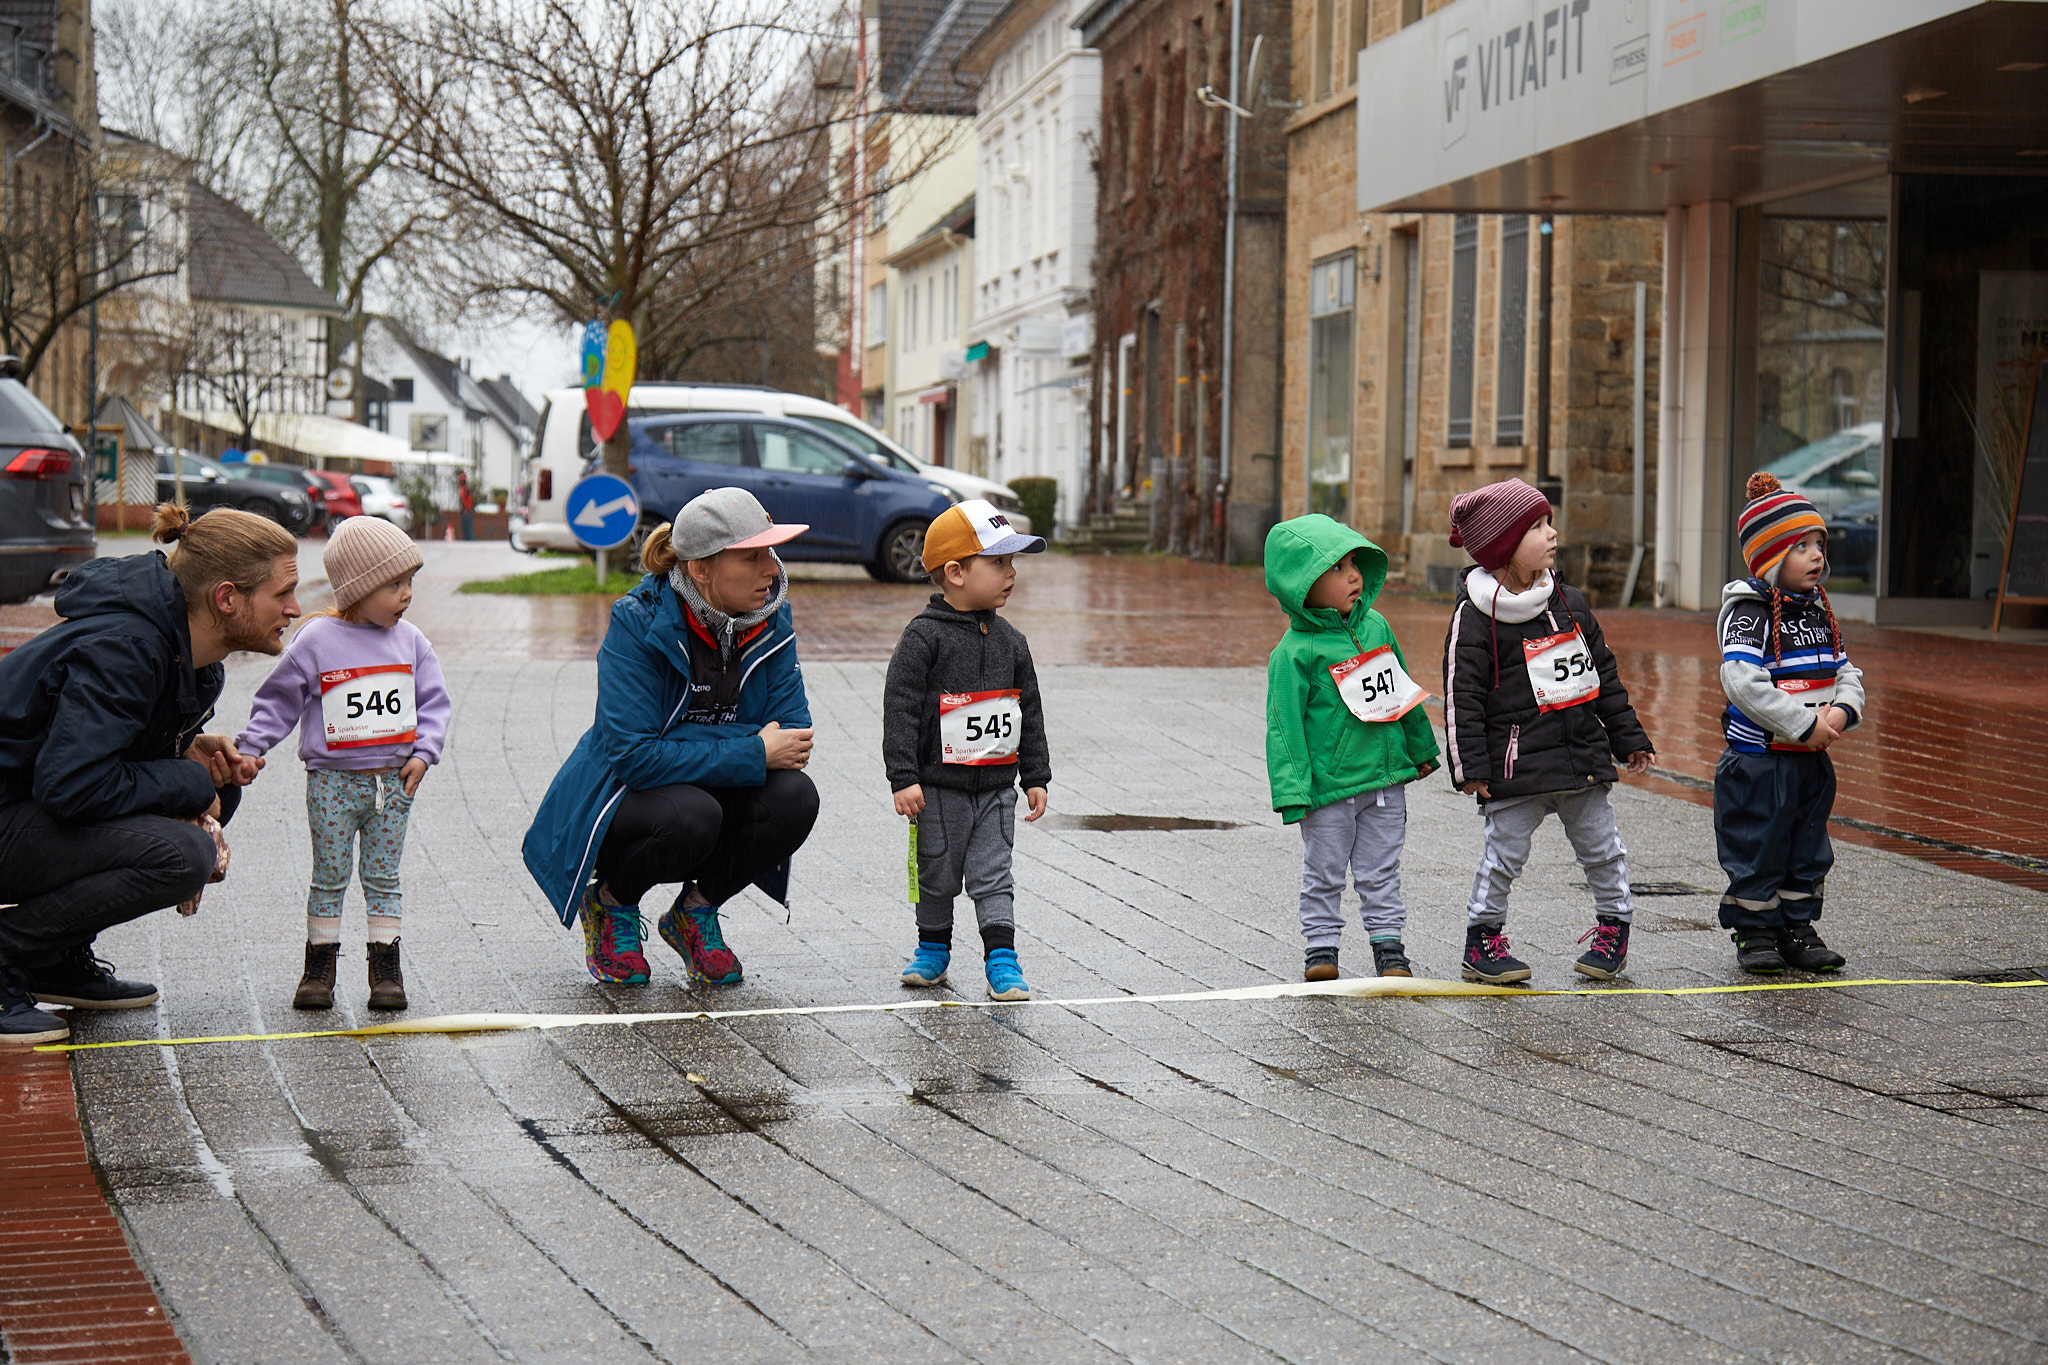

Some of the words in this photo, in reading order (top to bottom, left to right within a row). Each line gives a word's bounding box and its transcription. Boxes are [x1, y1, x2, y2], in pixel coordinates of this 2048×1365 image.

[1478, 0, 1590, 111] VITAFIT
[1613, 47, 1647, 73] FITNESS
[1780, 619, 1811, 634] asc
[1793, 631, 1828, 646] ahlen
[1361, 667, 1395, 703] 547
[1547, 685, 1577, 695] Sparkasse
[346, 688, 401, 719] 546
[338, 724, 369, 733] Sparkasse
[966, 712, 1012, 741] 545
[339, 733, 359, 741] Witten
[955, 747, 986, 755] Sparkasse
[908, 840, 916, 891] POLIZEI
